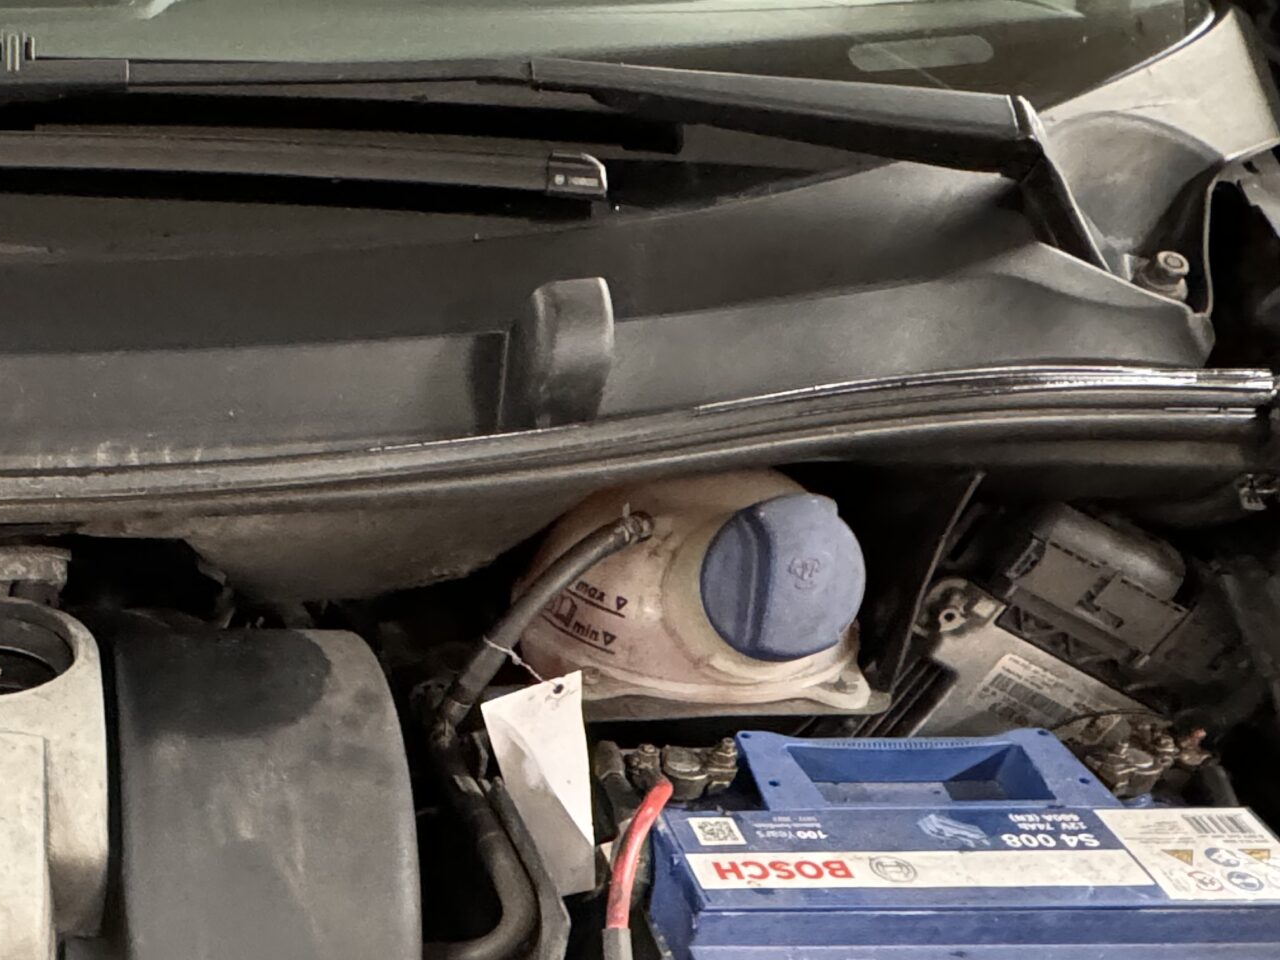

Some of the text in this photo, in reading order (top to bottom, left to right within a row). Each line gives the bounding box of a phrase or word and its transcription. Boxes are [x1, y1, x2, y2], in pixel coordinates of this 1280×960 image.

[576, 581, 605, 602] max
[573, 621, 599, 641] min
[796, 830, 828, 839] 100
[1000, 833, 1100, 848] S4 008
[712, 860, 855, 880] BOSCH
